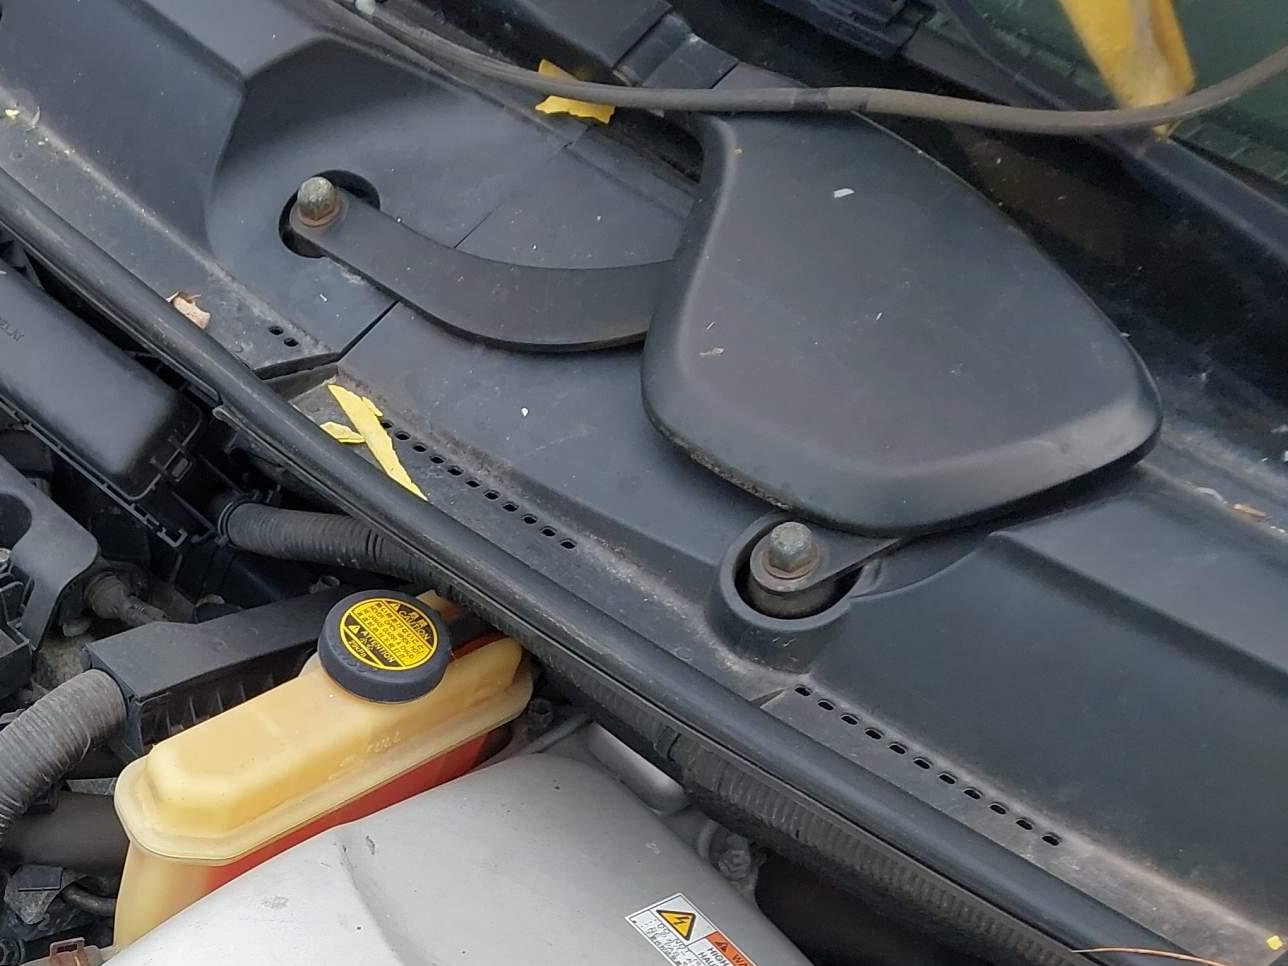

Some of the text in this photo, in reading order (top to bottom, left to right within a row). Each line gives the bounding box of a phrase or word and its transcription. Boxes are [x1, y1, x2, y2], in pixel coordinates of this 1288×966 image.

[396, 609, 432, 640] CAUTION
[357, 629, 397, 663] ATTENTION
[706, 946, 730, 966] HIGH
